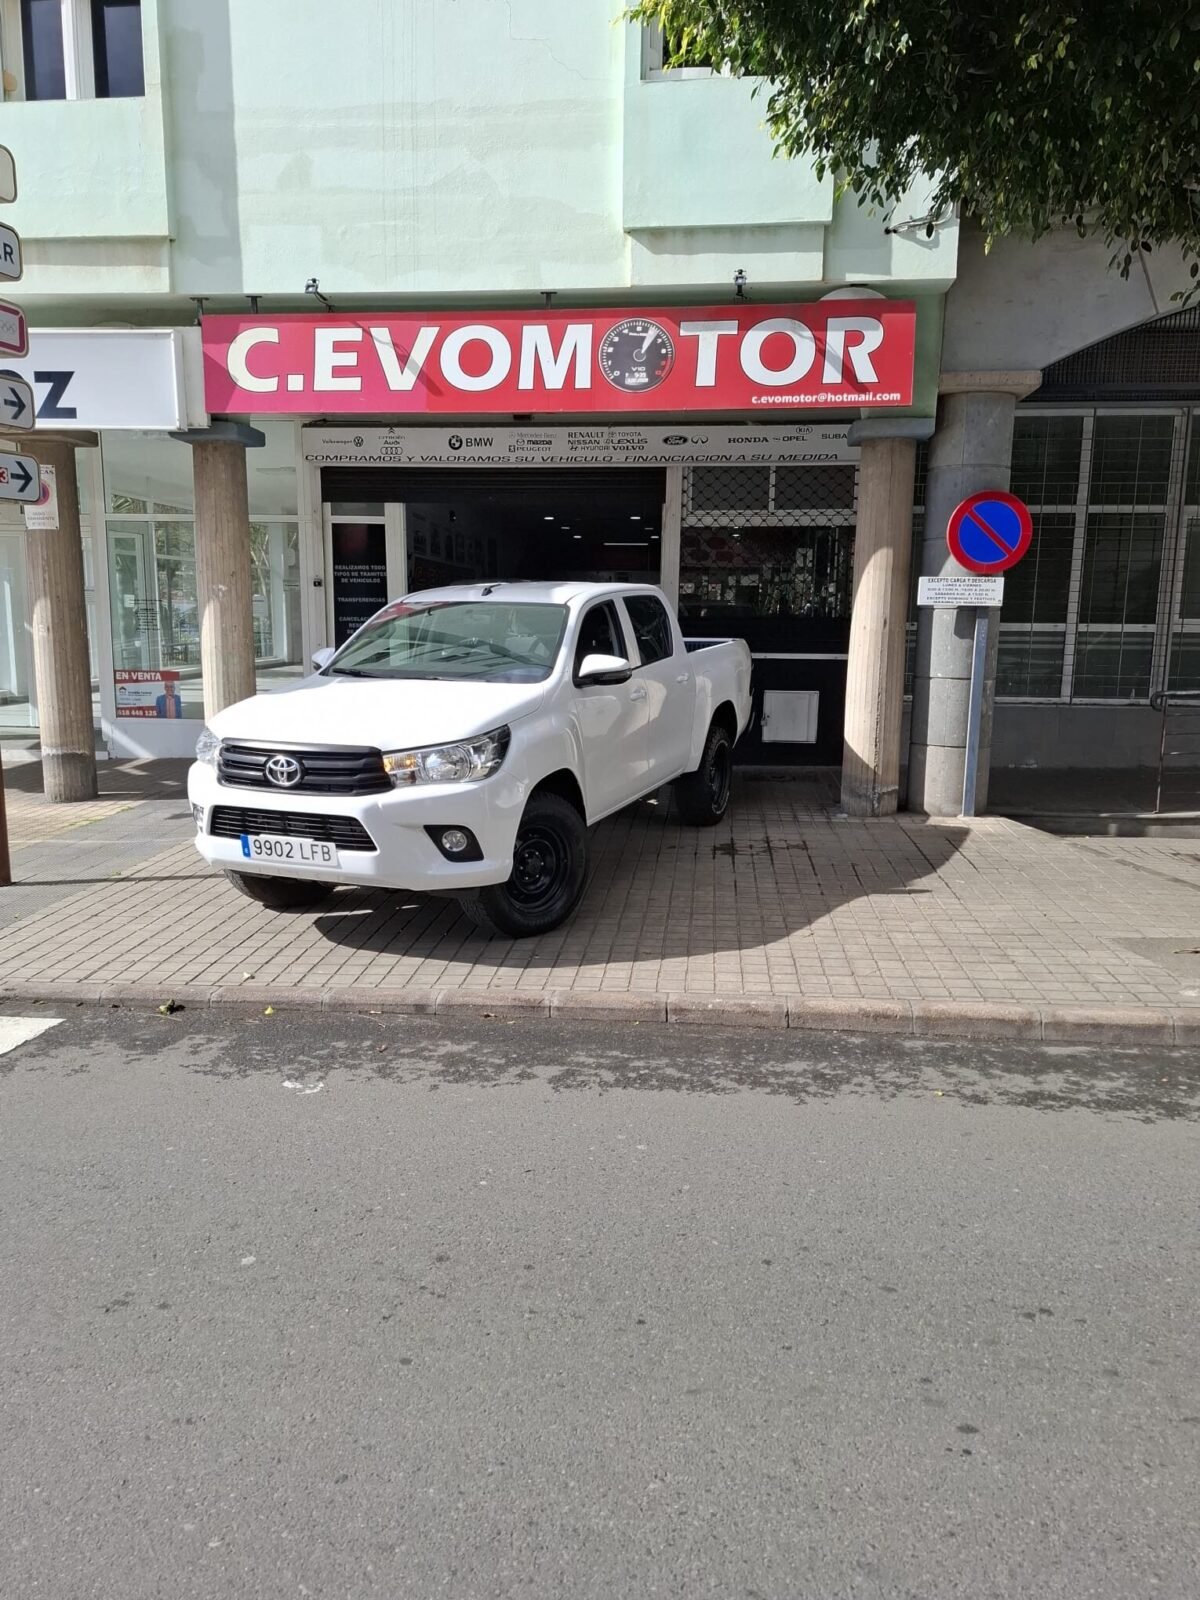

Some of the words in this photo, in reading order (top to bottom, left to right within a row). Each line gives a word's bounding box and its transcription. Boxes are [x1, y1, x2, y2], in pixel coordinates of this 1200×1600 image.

[751, 391, 901, 404] c.evomotor@hotmail.com
[567, 431, 605, 439] RENAULT
[727, 436, 770, 444] HONDA
[465, 437, 494, 447] BMW
[305, 454, 402, 463] COMPRAMOS
[406, 455, 416, 463] Y
[420, 455, 511, 463] VALORAMOS
[514, 455, 535, 463] SU
[541, 455, 612, 463] VEHICULO
[624, 454, 733, 463] FINANCIACION
[735, 454, 747, 462] A
[750, 453, 773, 462] SU
[777, 453, 839, 462] MEDIDA
[115, 671, 129, 680] EN
[131, 672, 162, 681] VENTA
[253, 838, 295, 859] 9902
[299, 842, 332, 862] LFB
